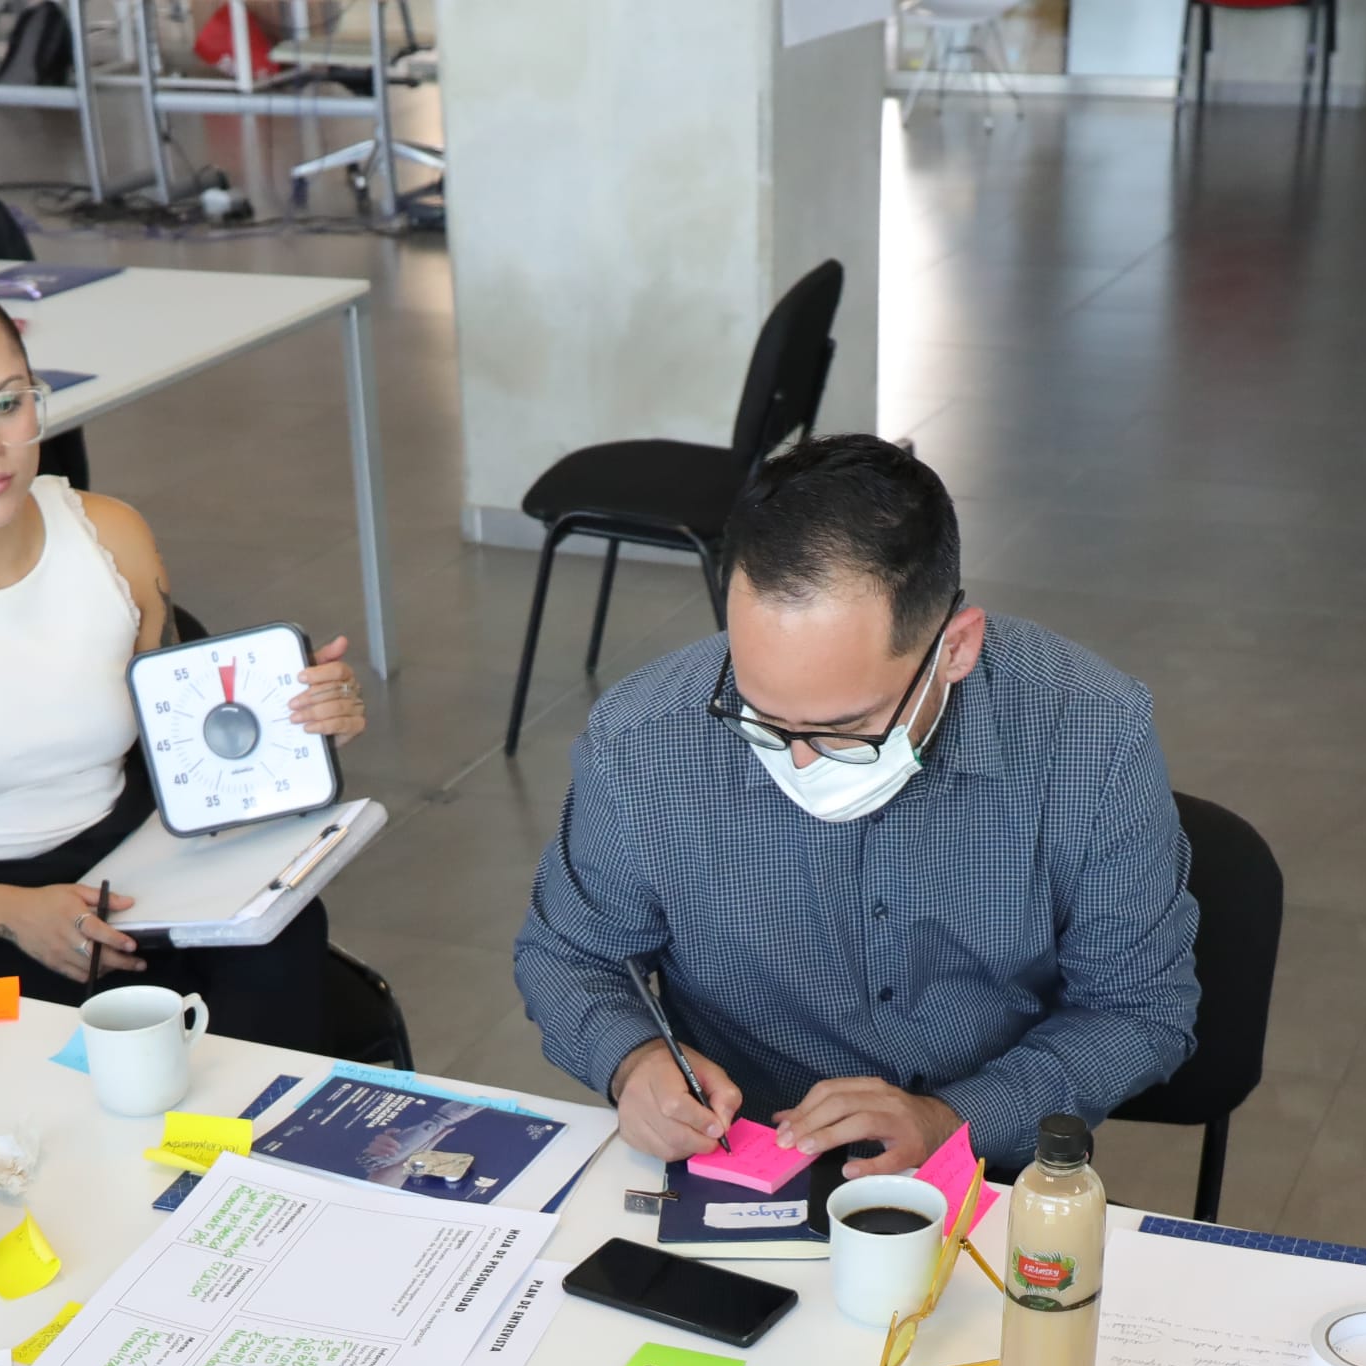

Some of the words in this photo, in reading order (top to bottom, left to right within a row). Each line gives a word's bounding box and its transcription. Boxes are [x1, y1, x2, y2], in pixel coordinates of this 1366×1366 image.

[211, 651, 219, 664] 0
[248, 652, 256, 664] 5
[174, 668, 190, 681] 55
[278, 673, 292, 686] 10
[155, 700, 171, 714] 50
[156, 739, 172, 753] 45
[294, 746, 309, 759] 20
[173, 772, 189, 785] 40
[275, 779, 290, 792] 25
[205, 795, 221, 808] 35
[731, 1204, 799, 1219] Edgar
[500, 1230, 520, 1247] HOJA
[493, 1250, 506, 1258] DE
[455, 1261, 499, 1312] PERSONALIDAD
[524, 1280, 543, 1298] PLAN
[517, 1301, 531, 1309] DE
[491, 1312, 524, 1351] ENTREVISTA
